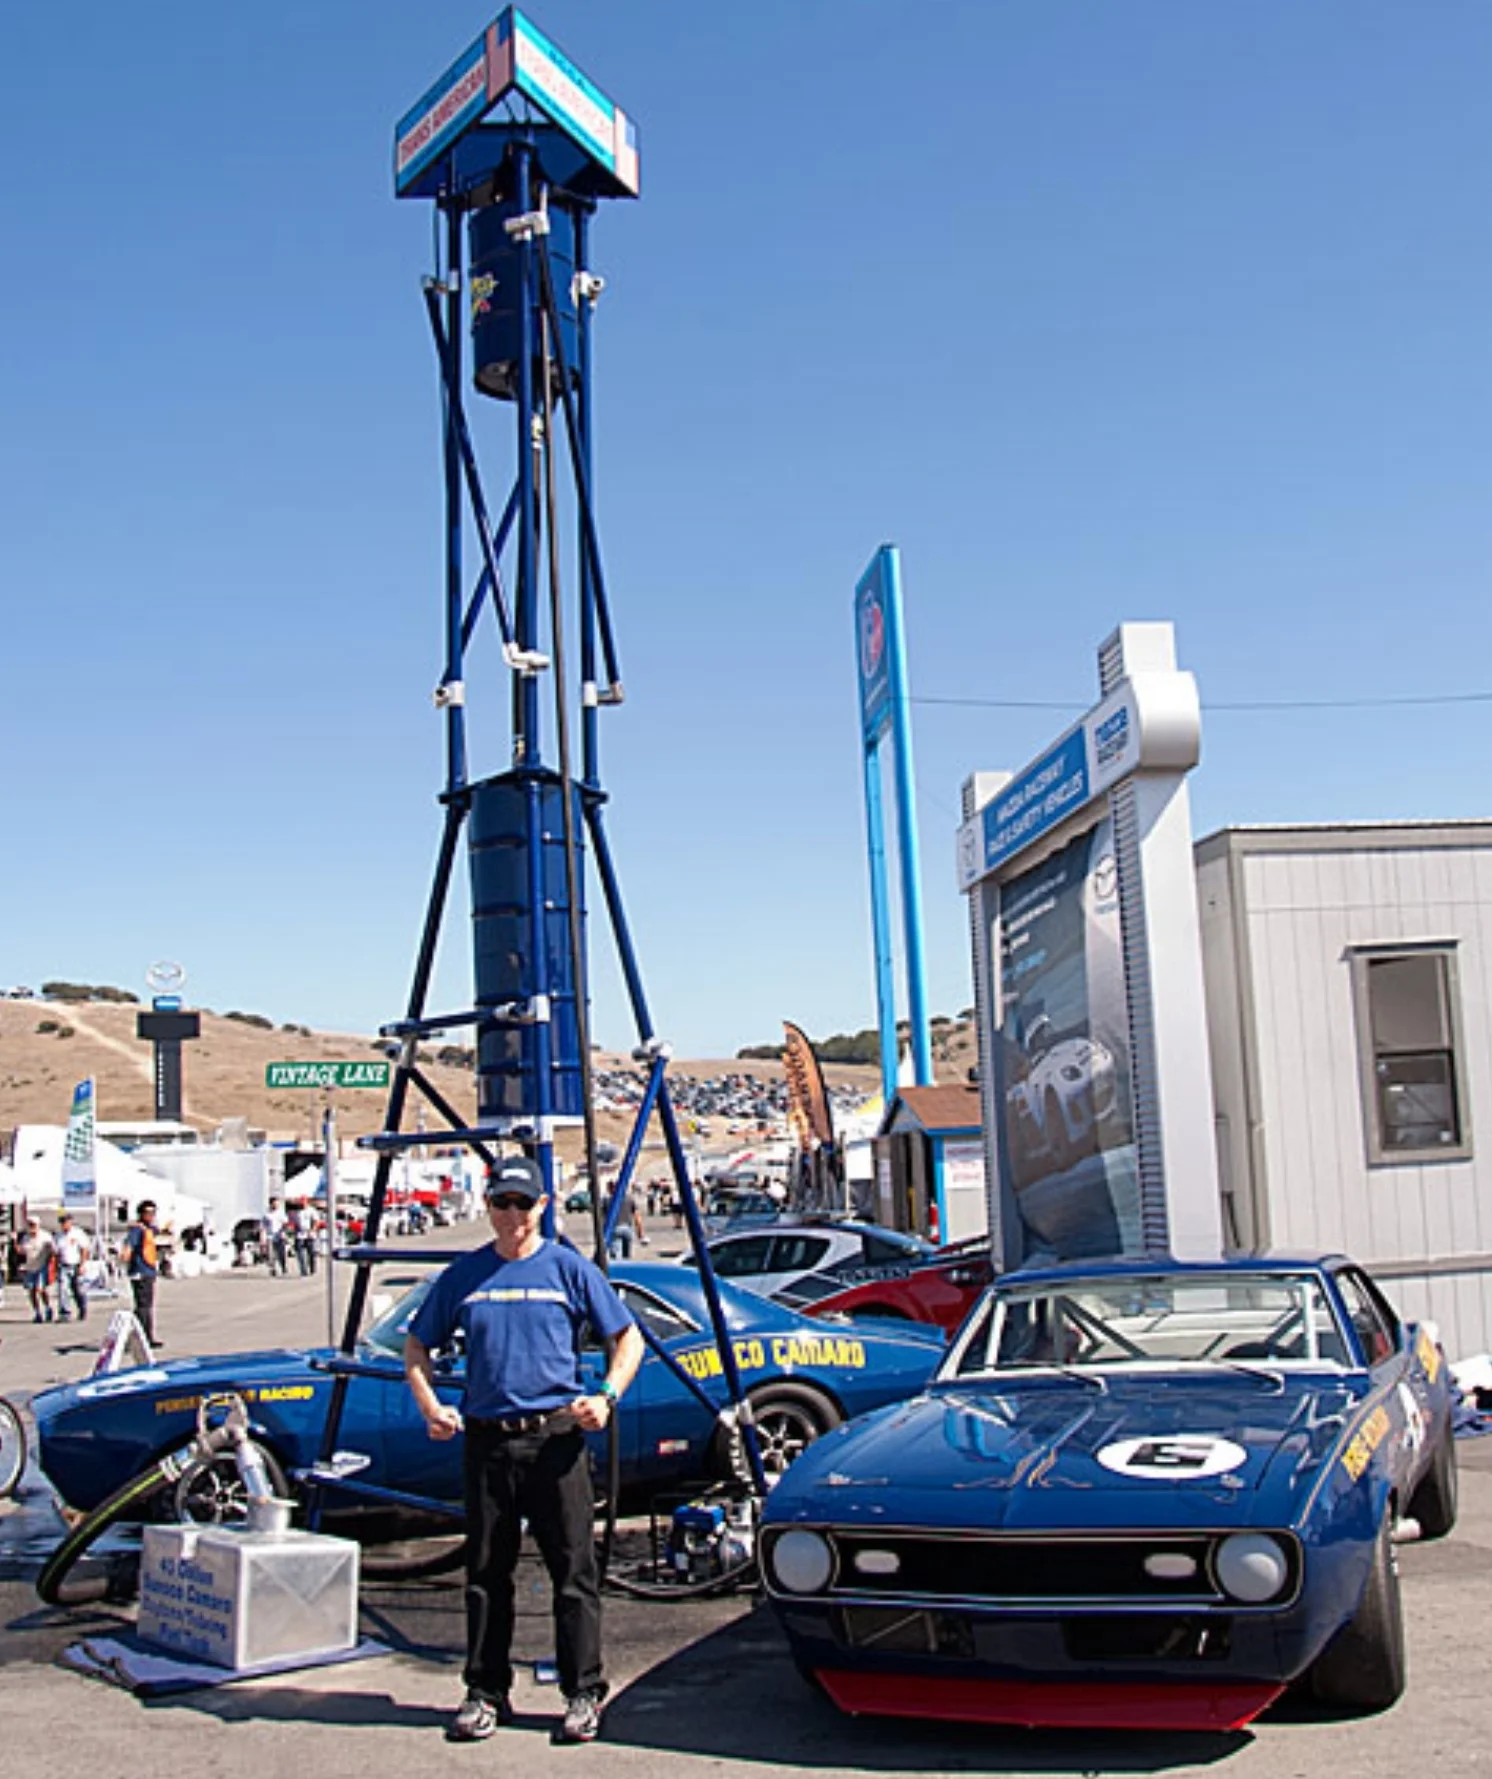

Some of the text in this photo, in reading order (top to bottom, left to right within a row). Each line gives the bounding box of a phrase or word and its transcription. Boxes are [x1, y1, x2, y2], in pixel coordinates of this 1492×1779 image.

[271, 1064, 387, 1084] VINTAGE LANE
[675, 1337, 866, 1380] SUNCO CAMARO
[1126, 1443, 1214, 1468] 6
